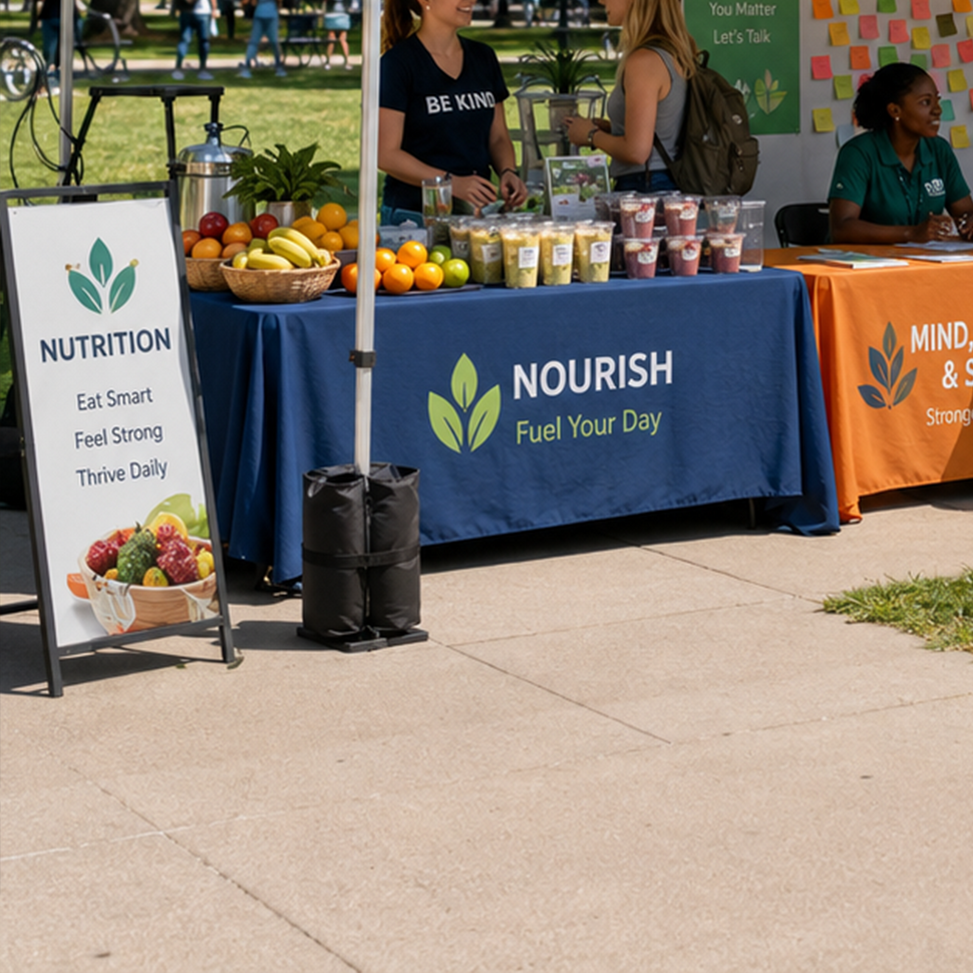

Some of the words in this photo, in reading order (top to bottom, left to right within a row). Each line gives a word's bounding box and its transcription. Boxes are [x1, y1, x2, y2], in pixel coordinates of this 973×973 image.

[708, 1, 733, 17] You
[735, 1, 778, 17] Matter
[712, 28, 745, 45] Let's
[745, 28, 772, 44] Talk
[425, 95, 454, 114] BE
[454, 90, 496, 111] KIND
[40, 327, 172, 363] NUTRITION
[513, 350, 674, 400] NOURISH
[941, 359, 959, 390] &
[76, 392, 103, 411] Eat
[106, 387, 154, 408] Smart
[75, 428, 108, 449] Feel
[111, 425, 164, 443] Strong
[516, 415, 562, 445] Fuel
[566, 413, 617, 439] Your
[622, 408, 663, 436] Day
[75, 465, 126, 487] Thrive
[129, 457, 168, 480] Daily
